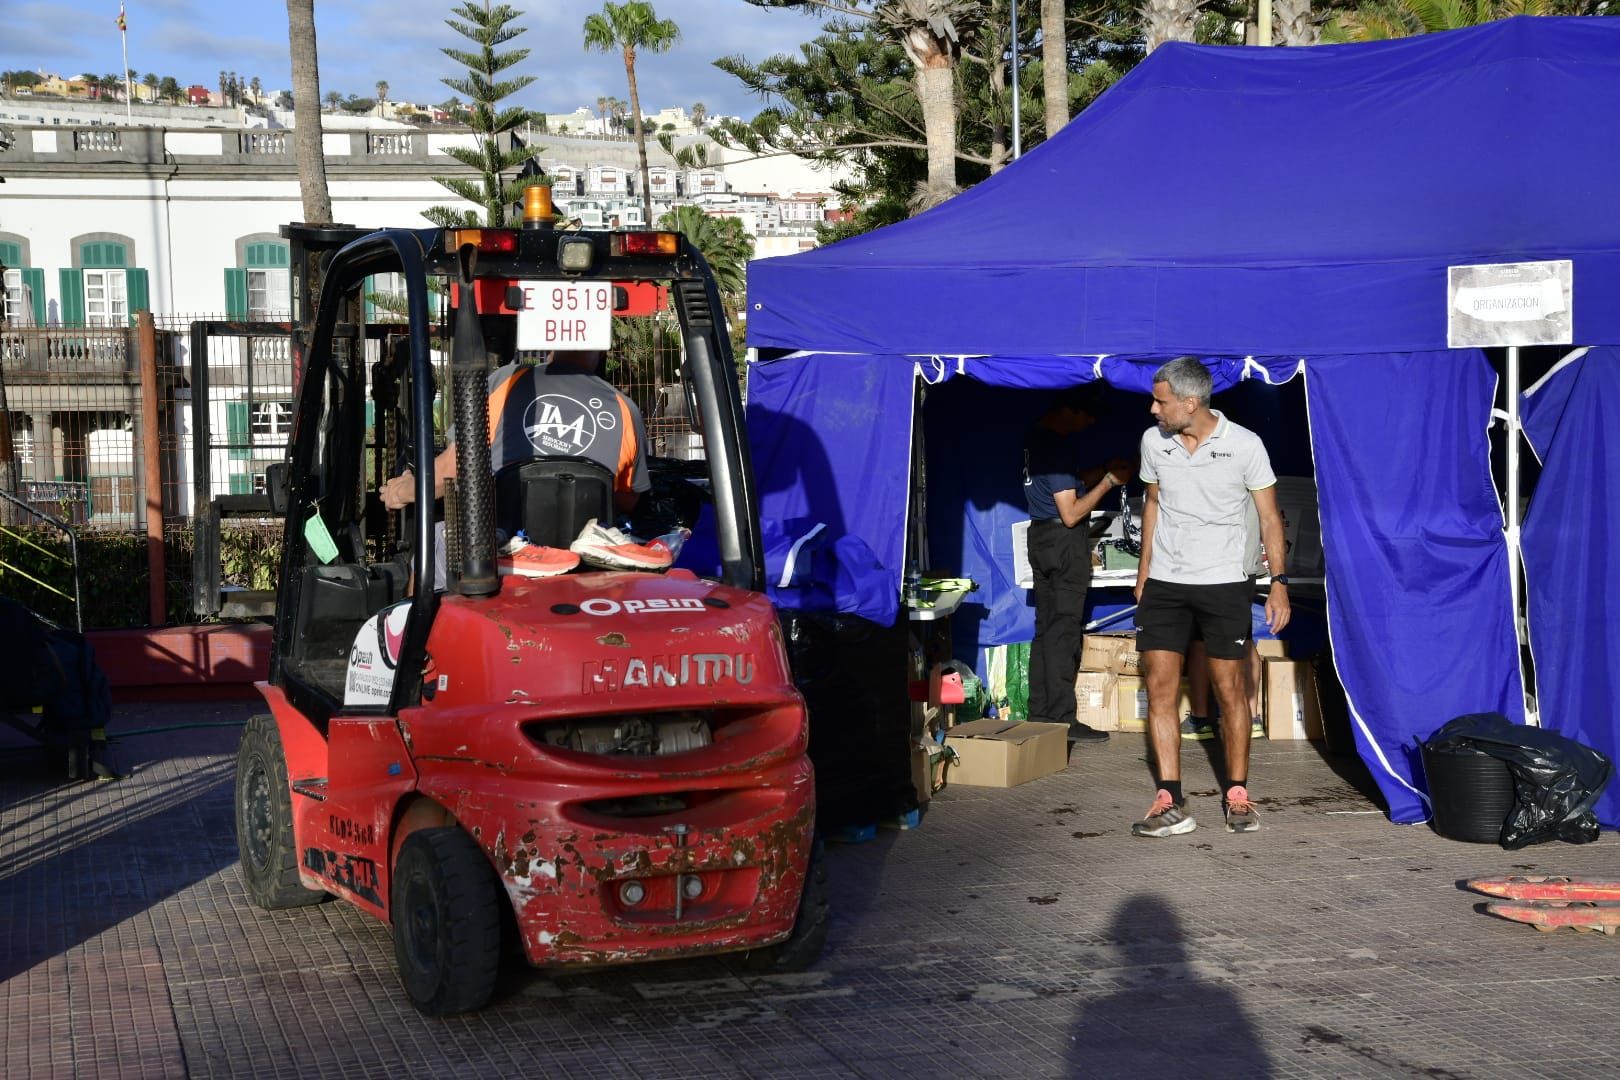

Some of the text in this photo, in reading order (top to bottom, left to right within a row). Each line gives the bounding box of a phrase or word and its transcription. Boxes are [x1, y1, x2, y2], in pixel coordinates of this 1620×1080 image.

[523, 288, 608, 310] E 9519
[545, 320, 587, 342] BHR
[579, 598, 706, 616] Opein
[351, 644, 373, 669] Opein
[582, 653, 755, 695] MANITOU
